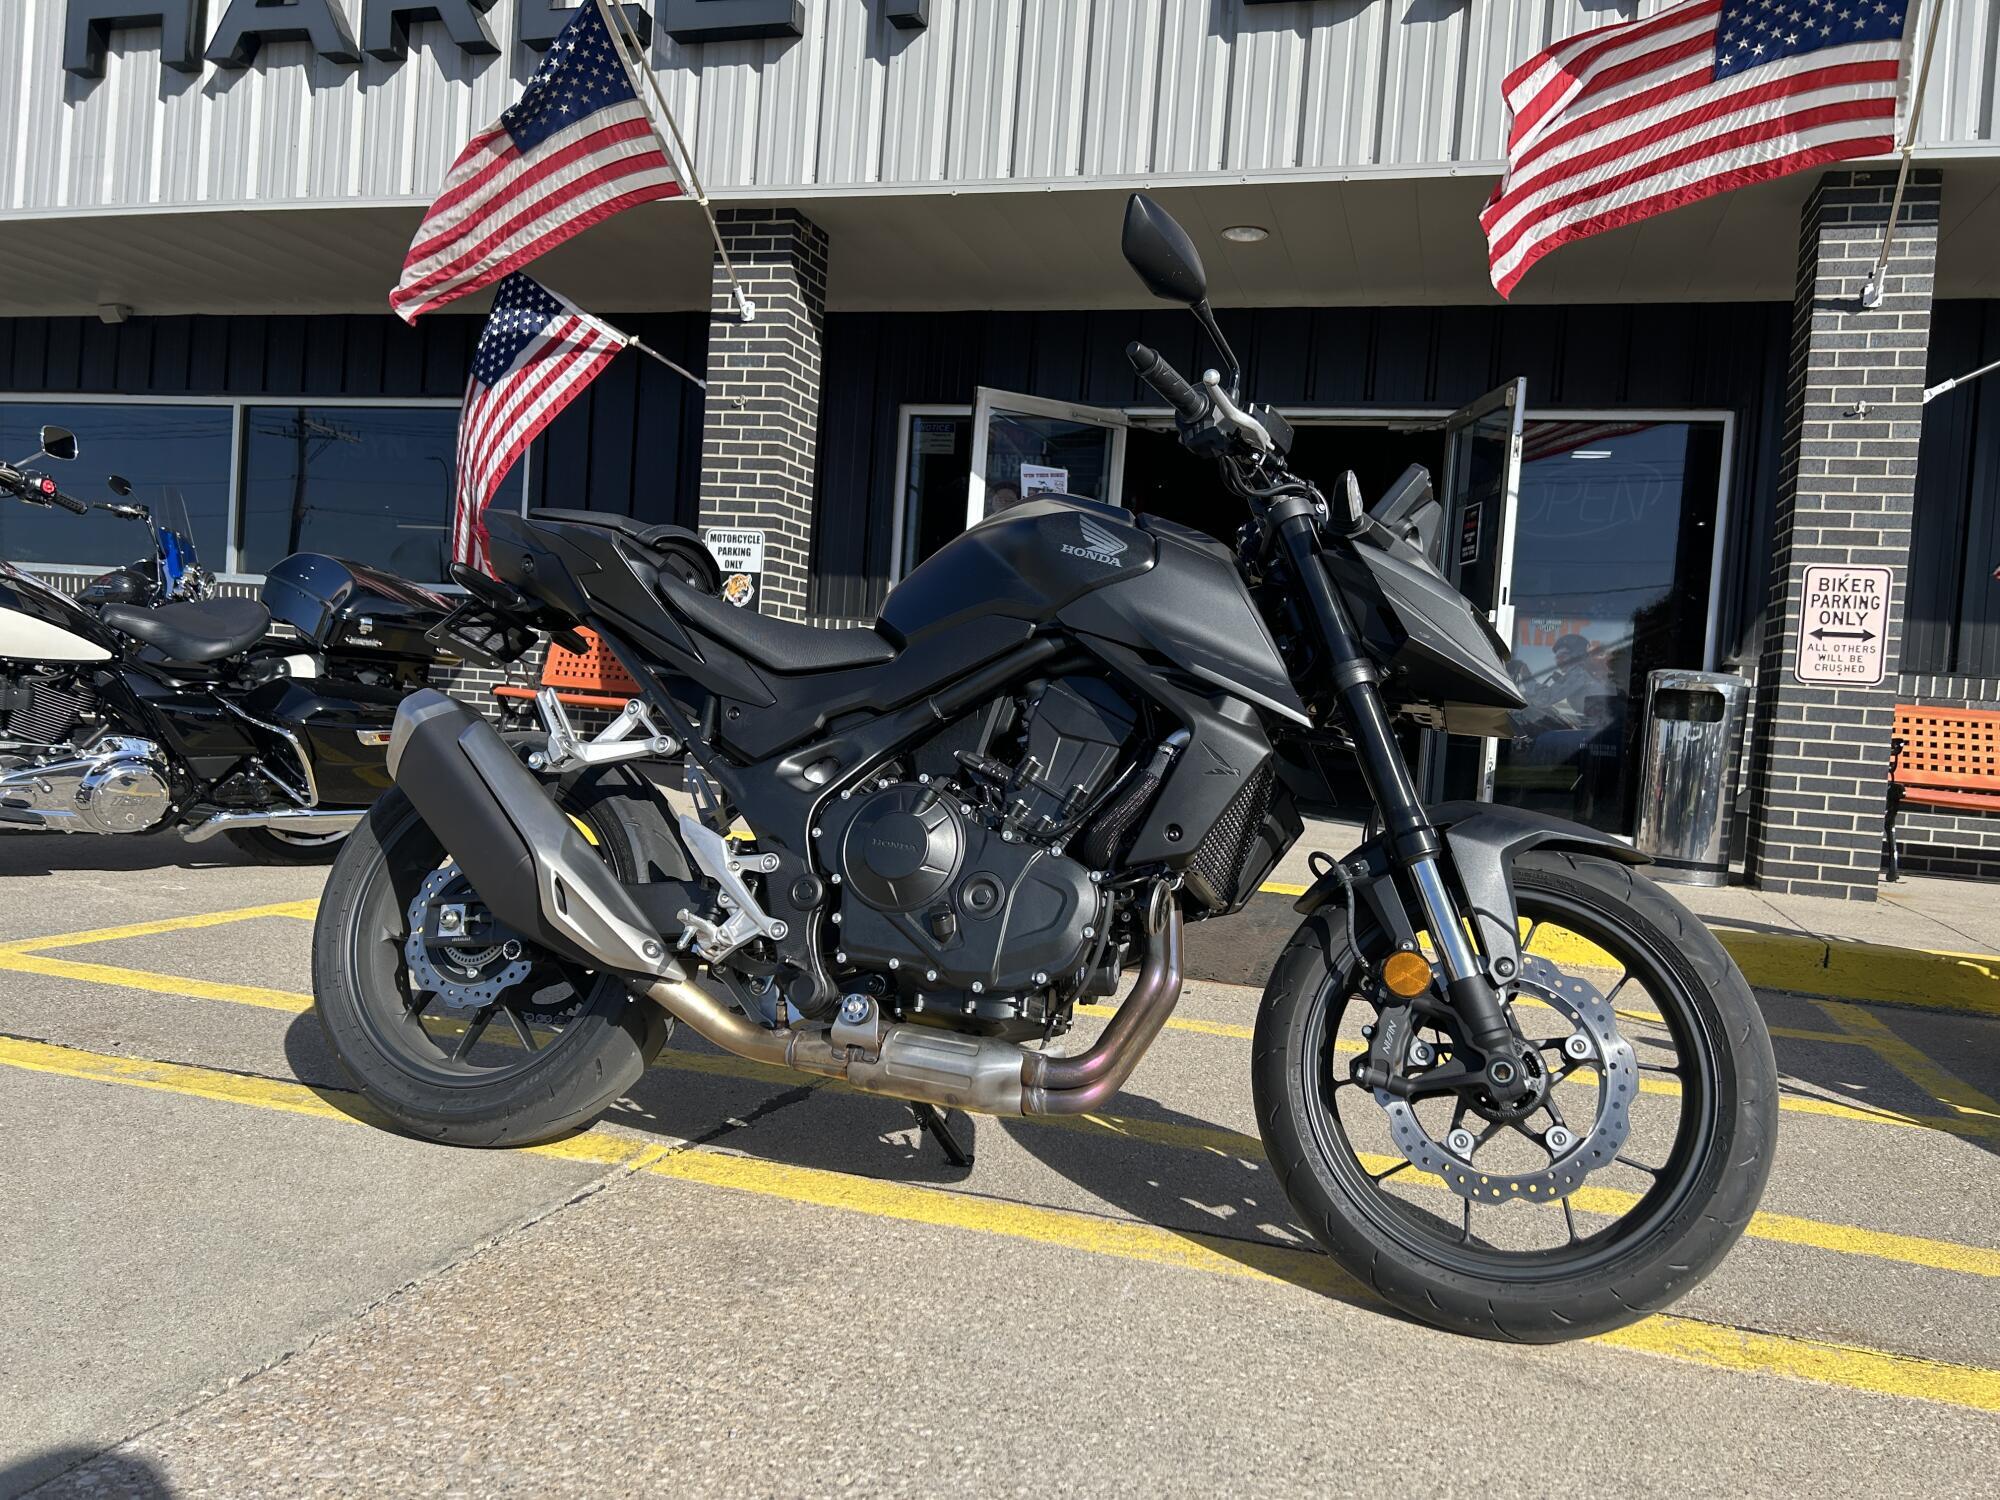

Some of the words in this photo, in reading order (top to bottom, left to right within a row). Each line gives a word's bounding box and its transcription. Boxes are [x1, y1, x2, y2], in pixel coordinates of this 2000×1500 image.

[710, 534, 760, 544] MOTORCYCLE
[717, 546, 752, 557] PARKING
[1060, 543, 1123, 568] HONDA
[724, 560, 743, 569] ONLY
[1818, 577, 1875, 593] BIKER
[1810, 594, 1880, 610] PARKING
[1819, 610, 1868, 626] ONLY
[1807, 643, 1828, 652] ALL
[1833, 644, 1876, 654] OTHERS
[1818, 654, 1843, 663] WILL
[1849, 655, 1863, 663] BE
[1814, 663, 1865, 673] CRUSHED
